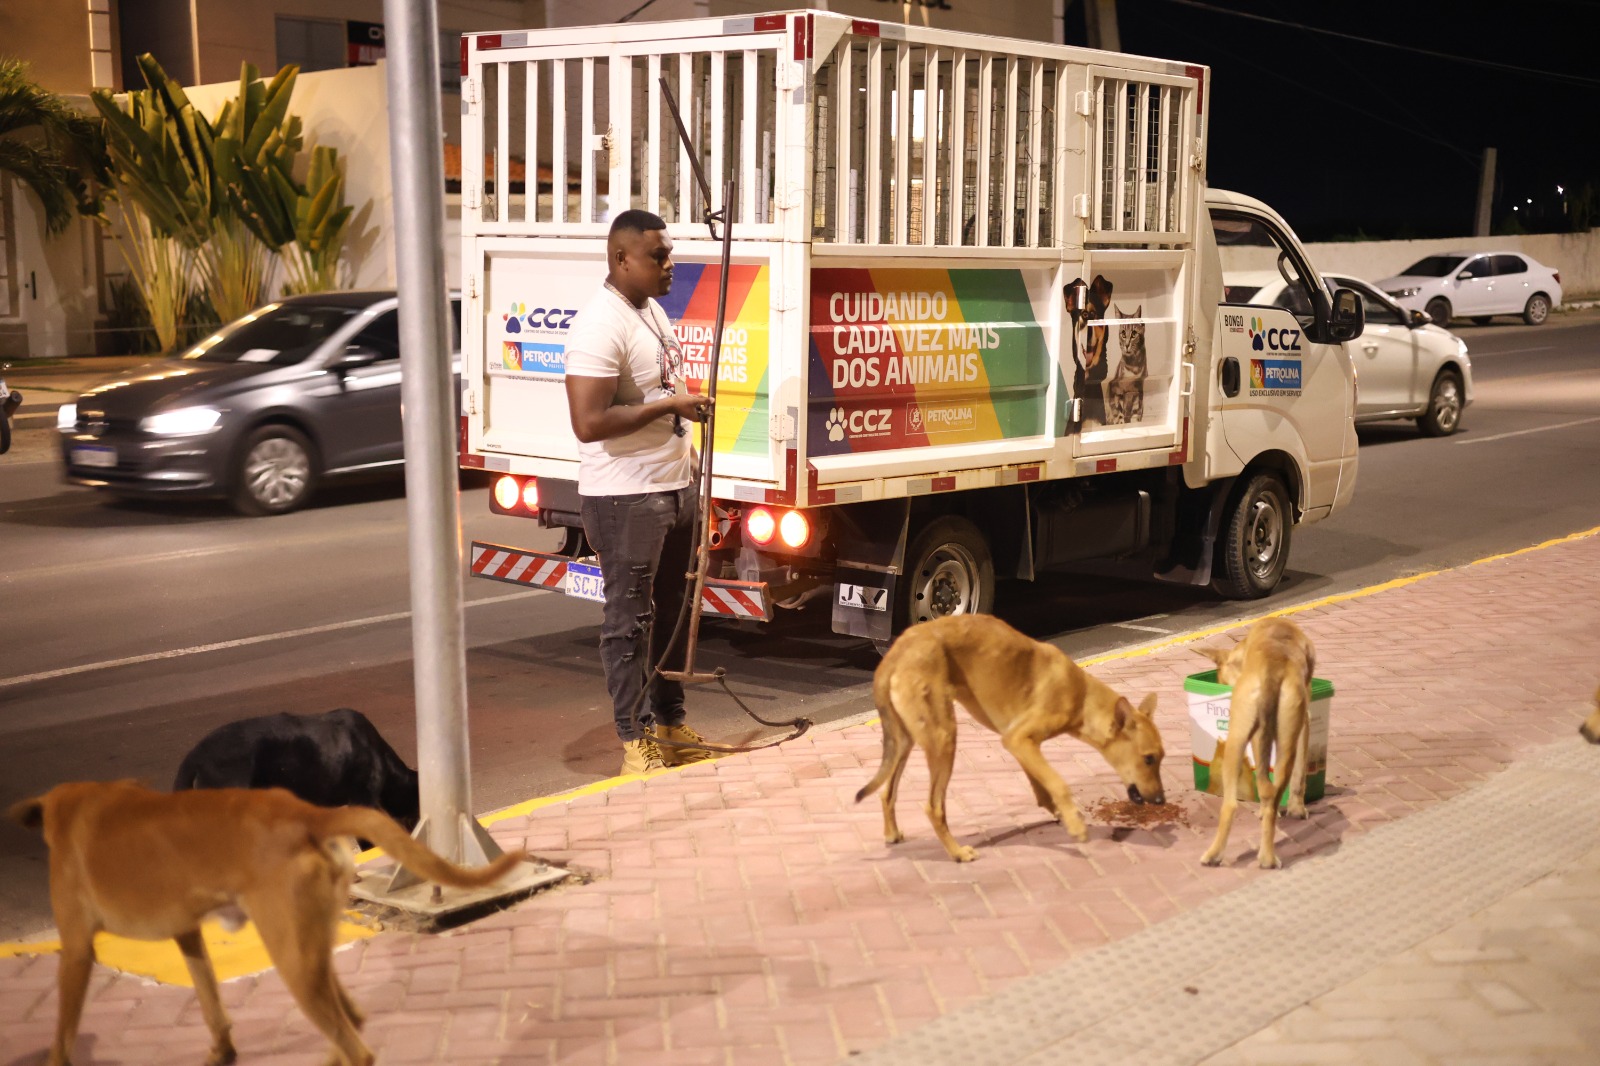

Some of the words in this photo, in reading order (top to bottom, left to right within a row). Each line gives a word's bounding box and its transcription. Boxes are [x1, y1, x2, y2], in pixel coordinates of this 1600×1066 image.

[527, 307, 578, 329] CCZ
[830, 291, 947, 323] CUIDANDO
[1224, 315, 1244, 327] BONGO
[673, 325, 747, 346] UIDADO
[833, 325, 896, 356] CADA
[901, 324, 944, 353] VEZ
[948, 323, 1000, 351] MAIS
[1268, 328, 1301, 351] CCZ
[833, 357, 880, 389] DOS
[884, 353, 978, 386] ANIMAIS
[1265, 367, 1299, 383] PETROLINA
[1287, 390, 1302, 398] SERVIÇO
[849, 409, 892, 433] CCZ
[927, 407, 972, 426] PETROLINA
